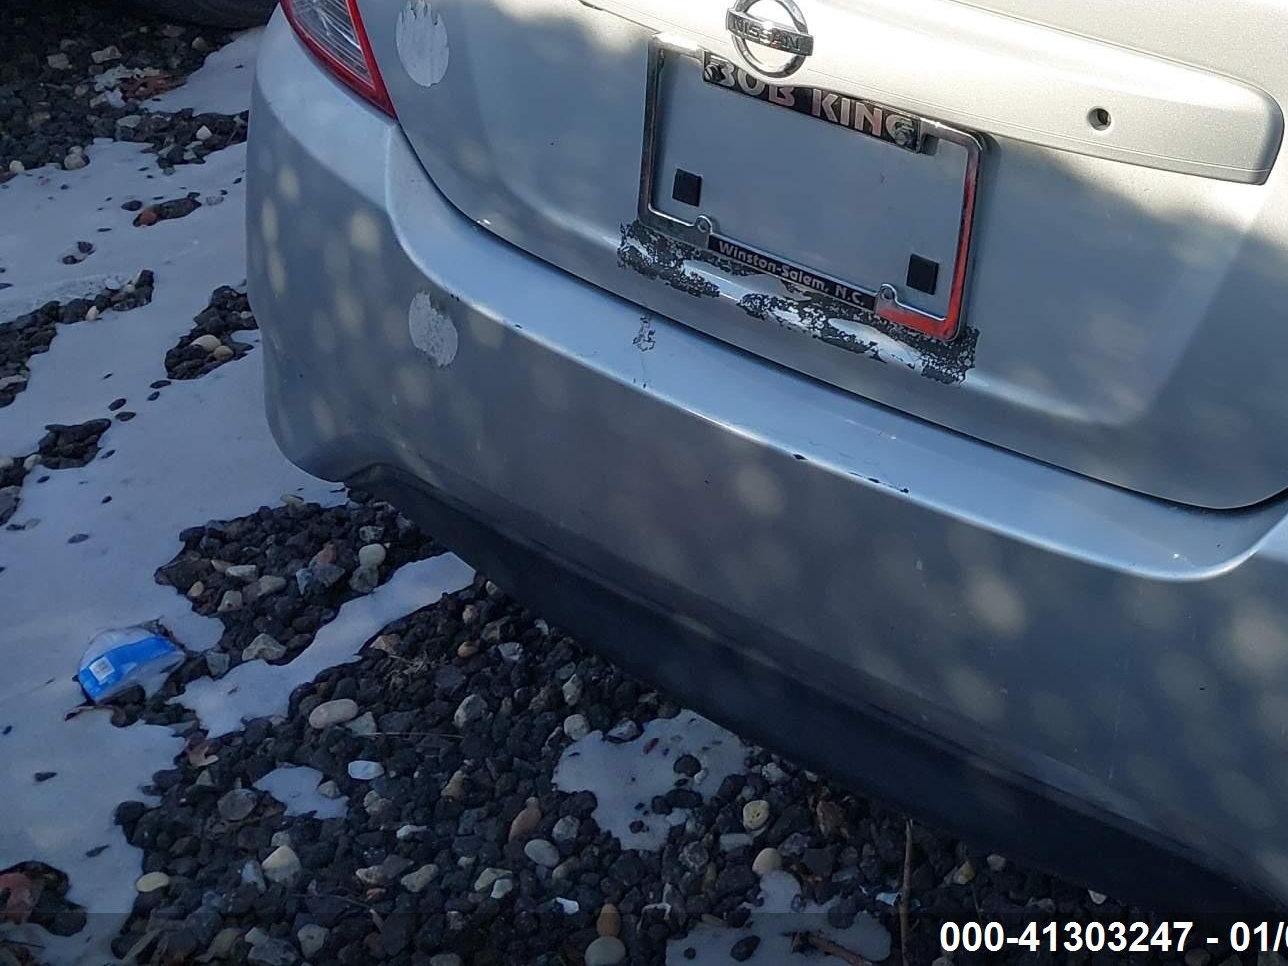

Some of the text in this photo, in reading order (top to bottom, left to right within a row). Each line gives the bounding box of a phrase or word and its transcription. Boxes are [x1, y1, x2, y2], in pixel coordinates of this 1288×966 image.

[733, 16, 802, 52] NISSAN
[719, 240, 864, 306] Winston-Salem, N.C.
